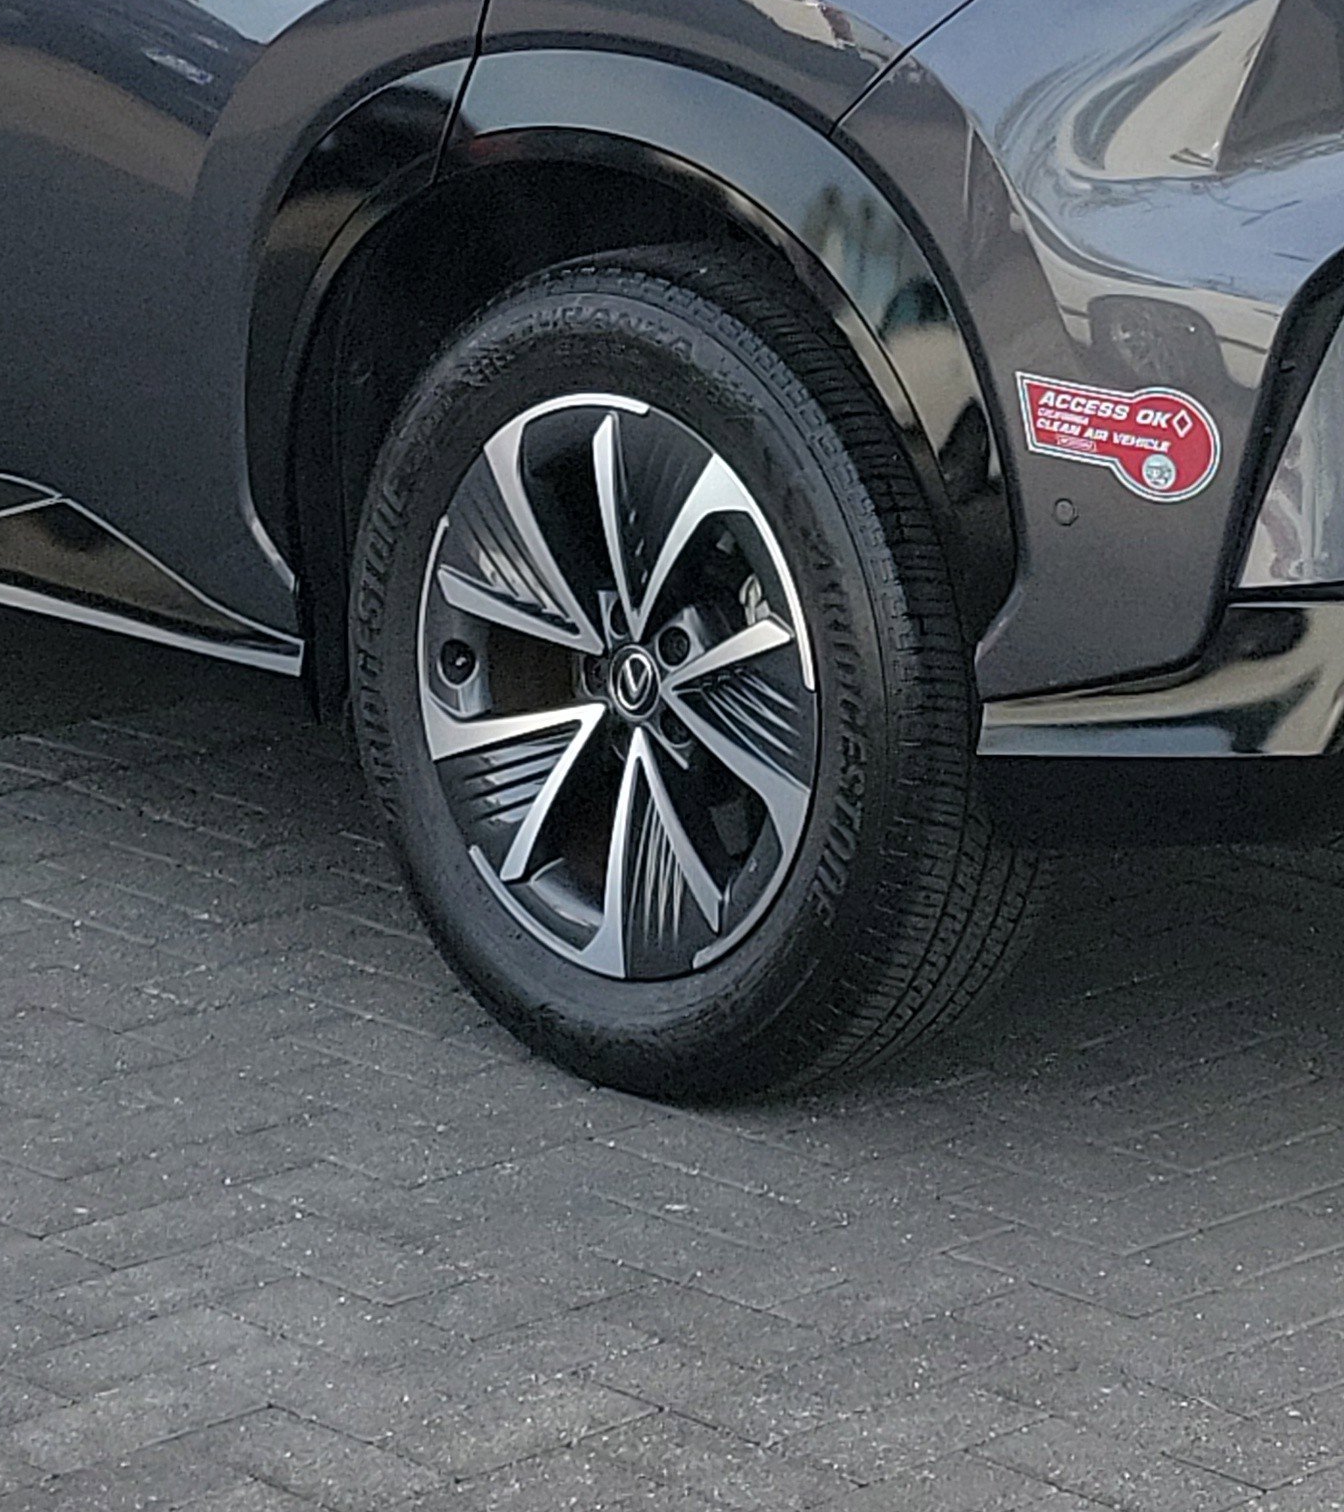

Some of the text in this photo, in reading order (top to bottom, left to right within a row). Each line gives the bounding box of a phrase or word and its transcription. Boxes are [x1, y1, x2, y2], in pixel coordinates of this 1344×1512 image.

[1038, 391, 1173, 429] ACCESS OK
[1036, 418, 1082, 436] CLEAN
[1083, 427, 1109, 441] AIR
[1112, 431, 1172, 453] VEHICLE
